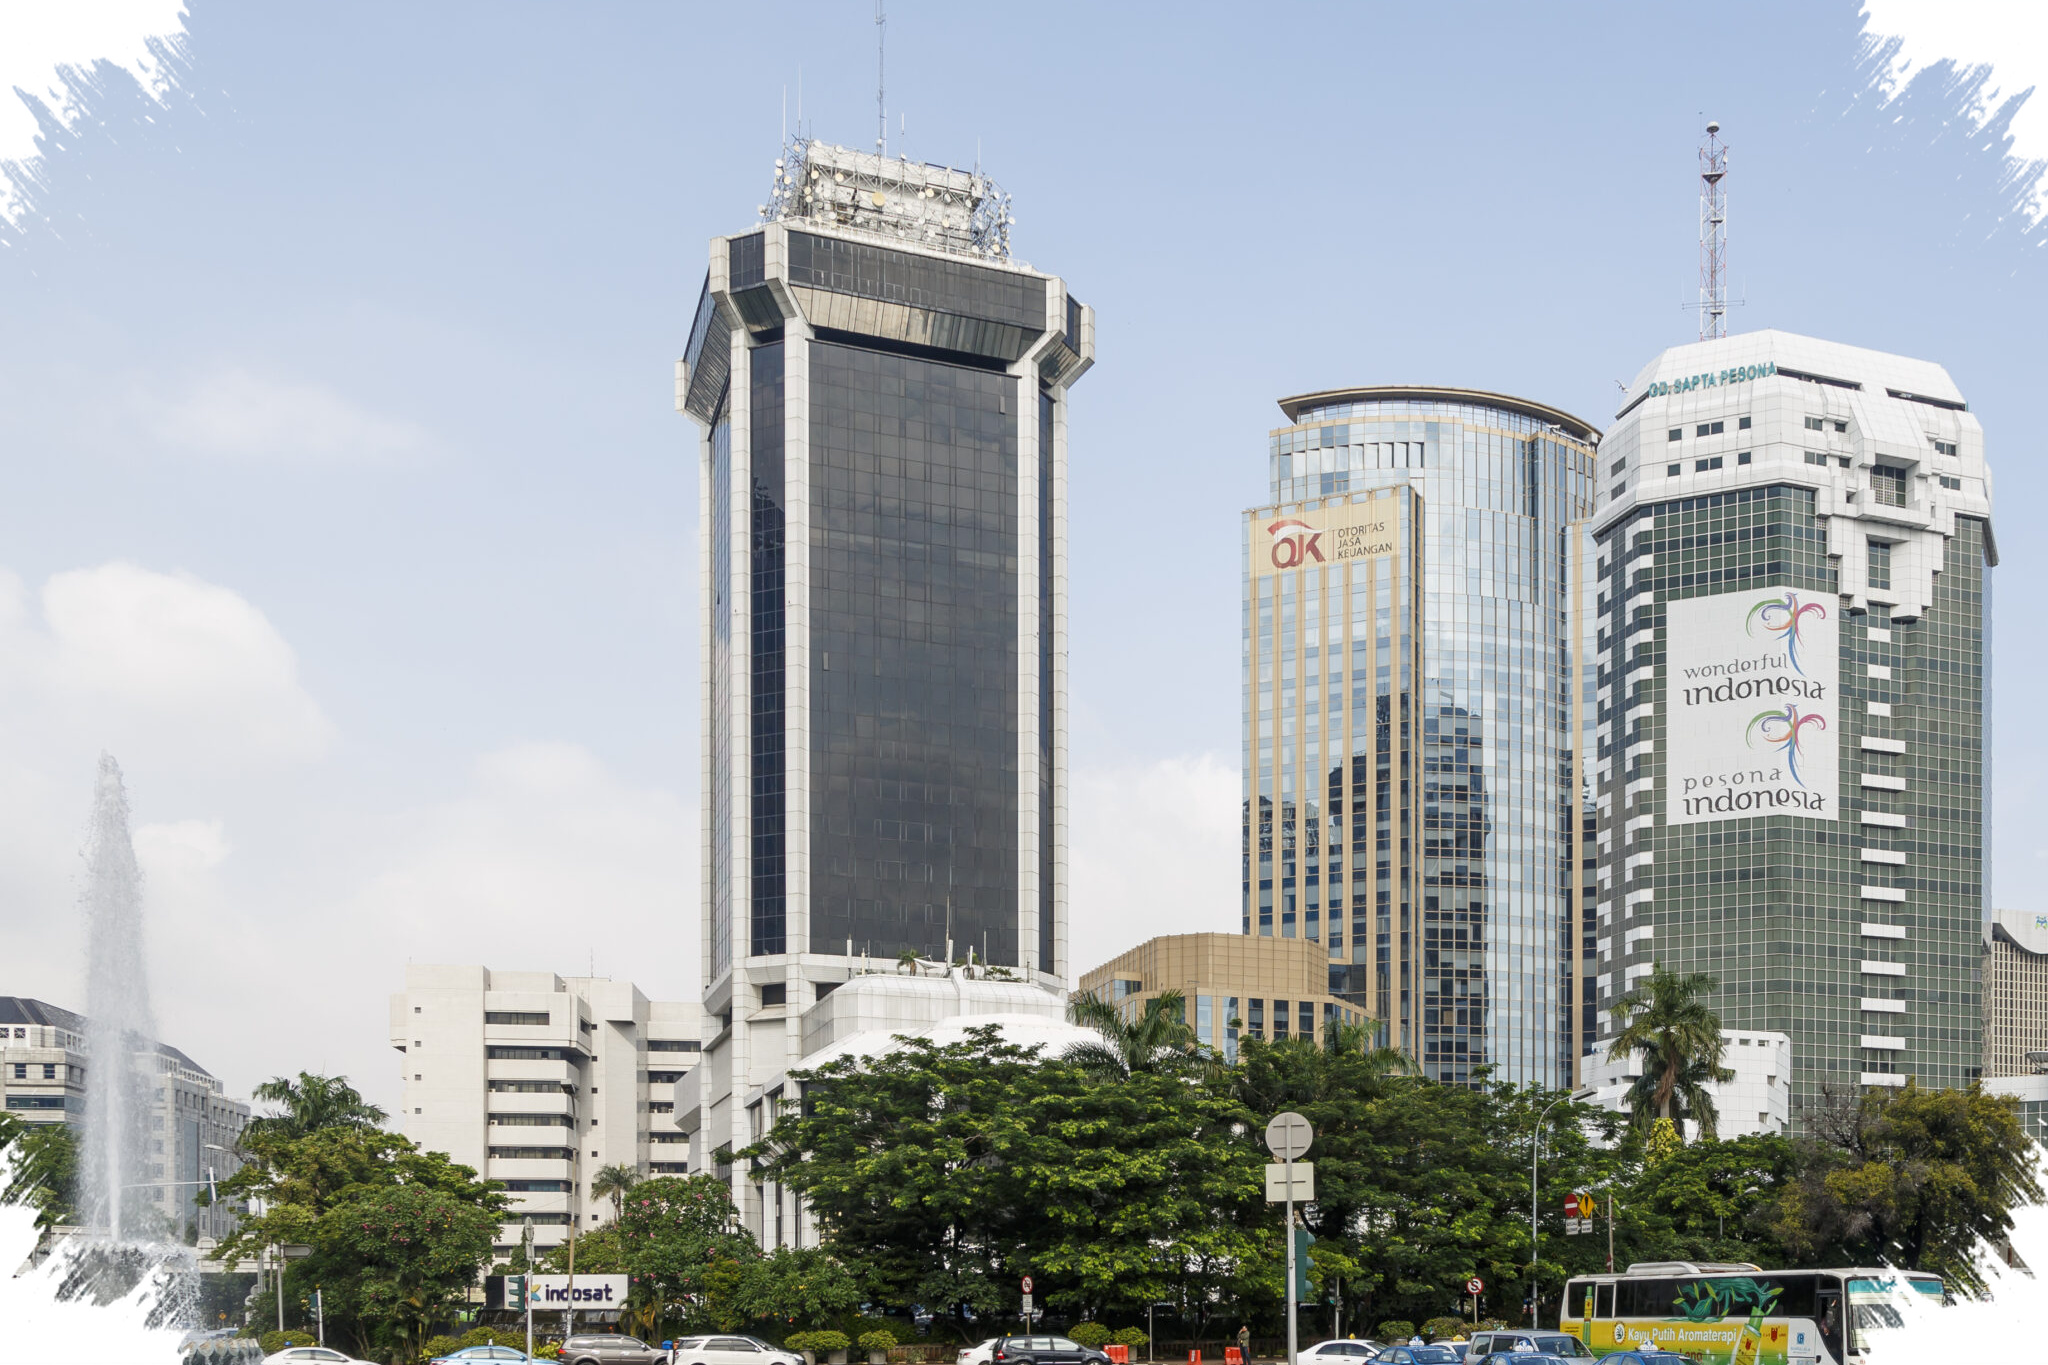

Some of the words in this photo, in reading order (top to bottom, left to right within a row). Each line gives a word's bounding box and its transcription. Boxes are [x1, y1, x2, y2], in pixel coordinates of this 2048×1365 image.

[1648, 381, 1671, 397] GD.
[1673, 372, 1717, 394] SAPTA
[1720, 361, 1778, 386] PESONA
[1338, 522, 1384, 538] OTORITAS
[1337, 537, 1361, 549] JASA
[1337, 542, 1392, 559] KEUANGAN
[1683, 653, 1788, 679] wonderful
[1683, 676, 1825, 705] indonesia
[1683, 768, 1783, 795] pesona
[1683, 788, 1825, 816] indonesia
[545, 1283, 613, 1301] indosat
[1628, 1328, 1650, 1343] Kayu
[1652, 1328, 1676, 1341] Putih
[1678, 1328, 1737, 1345] Aromaterapi
